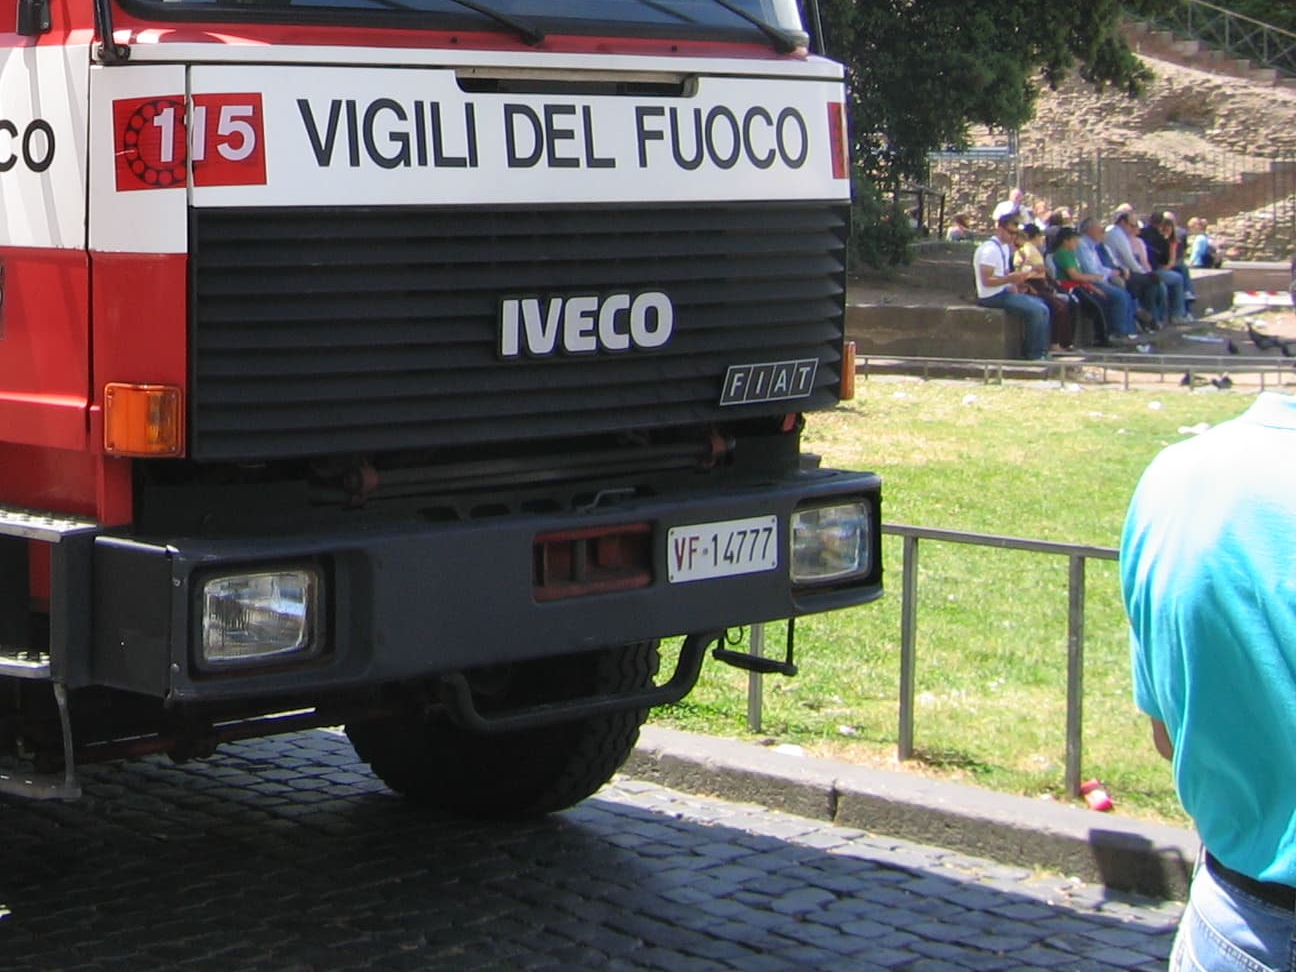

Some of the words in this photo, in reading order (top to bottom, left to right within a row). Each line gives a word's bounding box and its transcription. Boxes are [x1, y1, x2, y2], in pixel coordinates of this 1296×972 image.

[153, 105, 257, 163] 115
[296, 97, 479, 169] VIGILI
[503, 103, 617, 169] DEL
[635, 104, 809, 171] FUOCO
[501, 291, 674, 357] IVECO
[729, 366, 812, 398] FIAT
